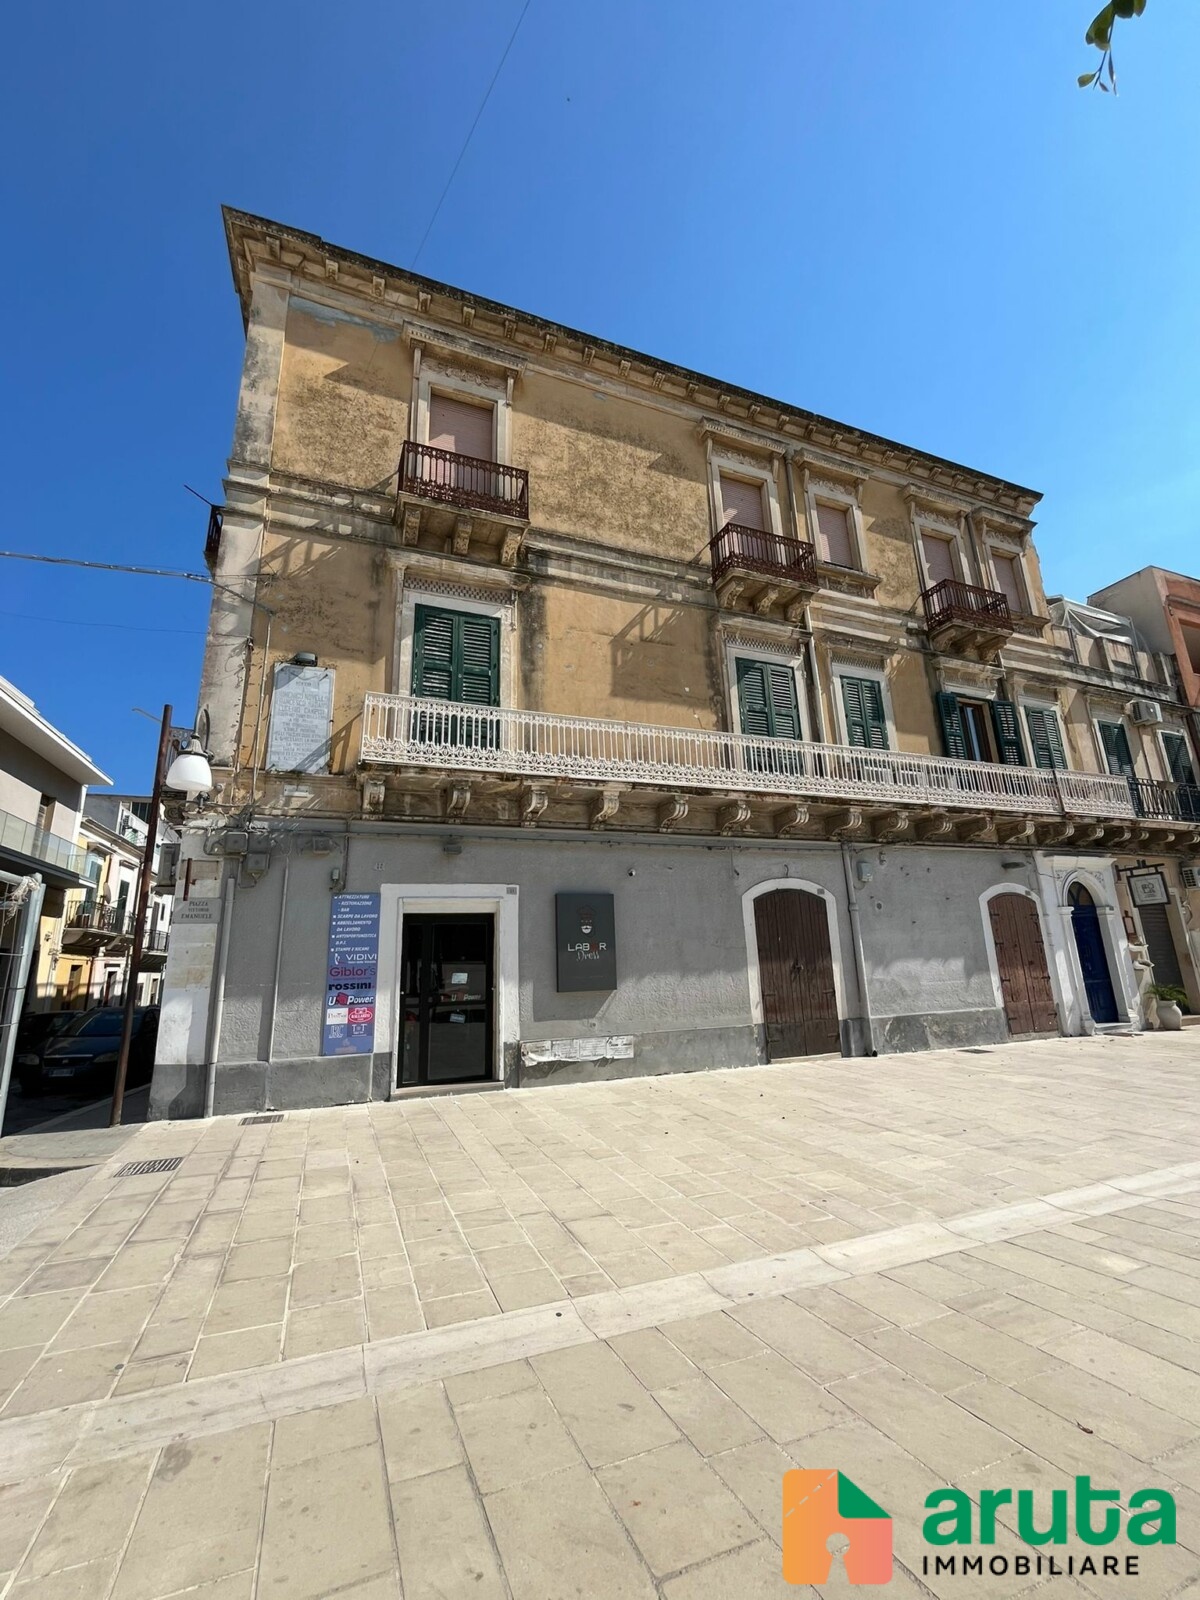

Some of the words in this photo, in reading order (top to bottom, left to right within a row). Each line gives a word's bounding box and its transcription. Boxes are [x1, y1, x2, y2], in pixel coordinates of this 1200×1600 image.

[345, 953, 377, 961] VIDIVI
[329, 966, 376, 977] Giblor's
[328, 982, 372, 991] rossini
